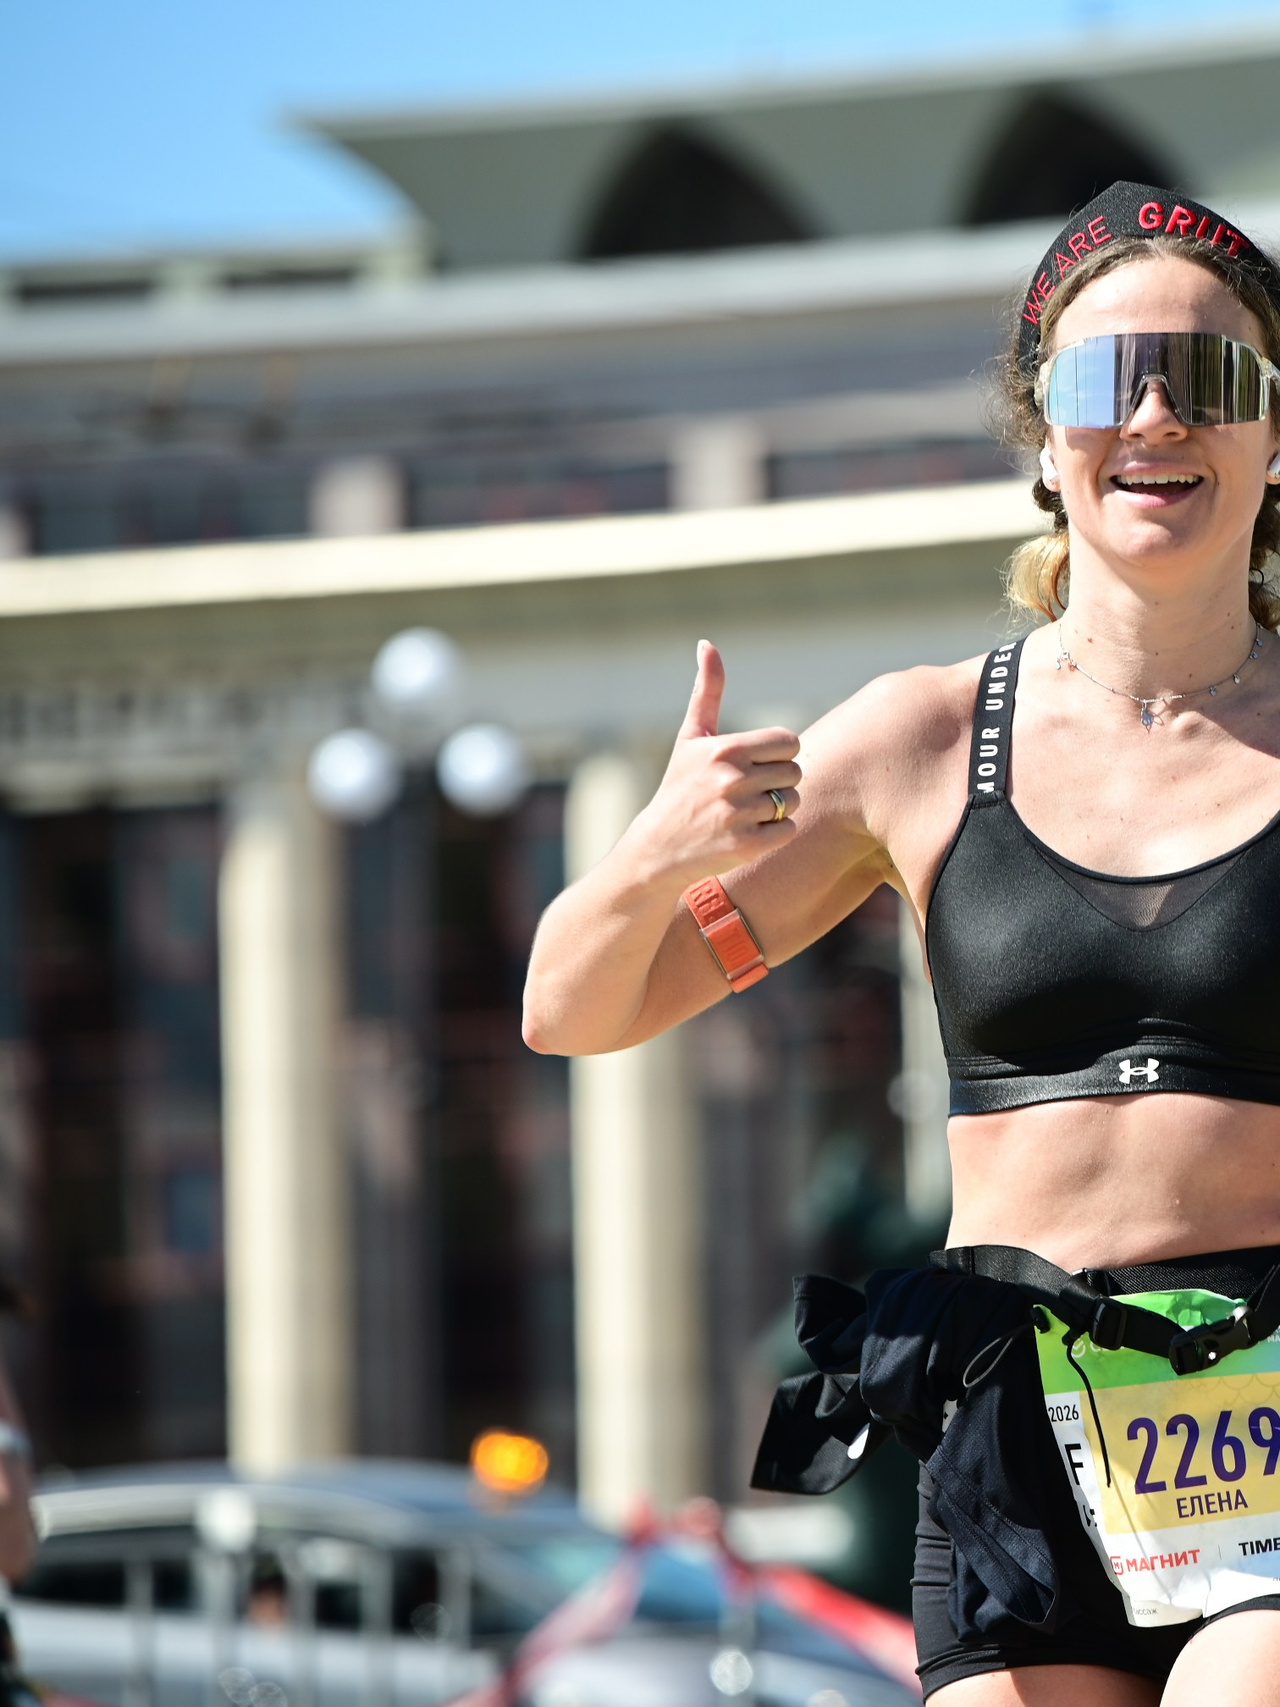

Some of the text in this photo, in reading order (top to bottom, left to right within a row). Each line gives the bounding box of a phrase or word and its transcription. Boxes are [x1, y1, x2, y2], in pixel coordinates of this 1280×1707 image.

[1022, 271, 1056, 325] WE
[1055, 215, 1113, 280] ARE
[1048, 1404, 1079, 1423] 2026
[1064, 1443, 1084, 1486] F
[1176, 1489, 1249, 1519] ЕЛЕНА
[1125, 1548, 1200, 1572] МАГНИТ
